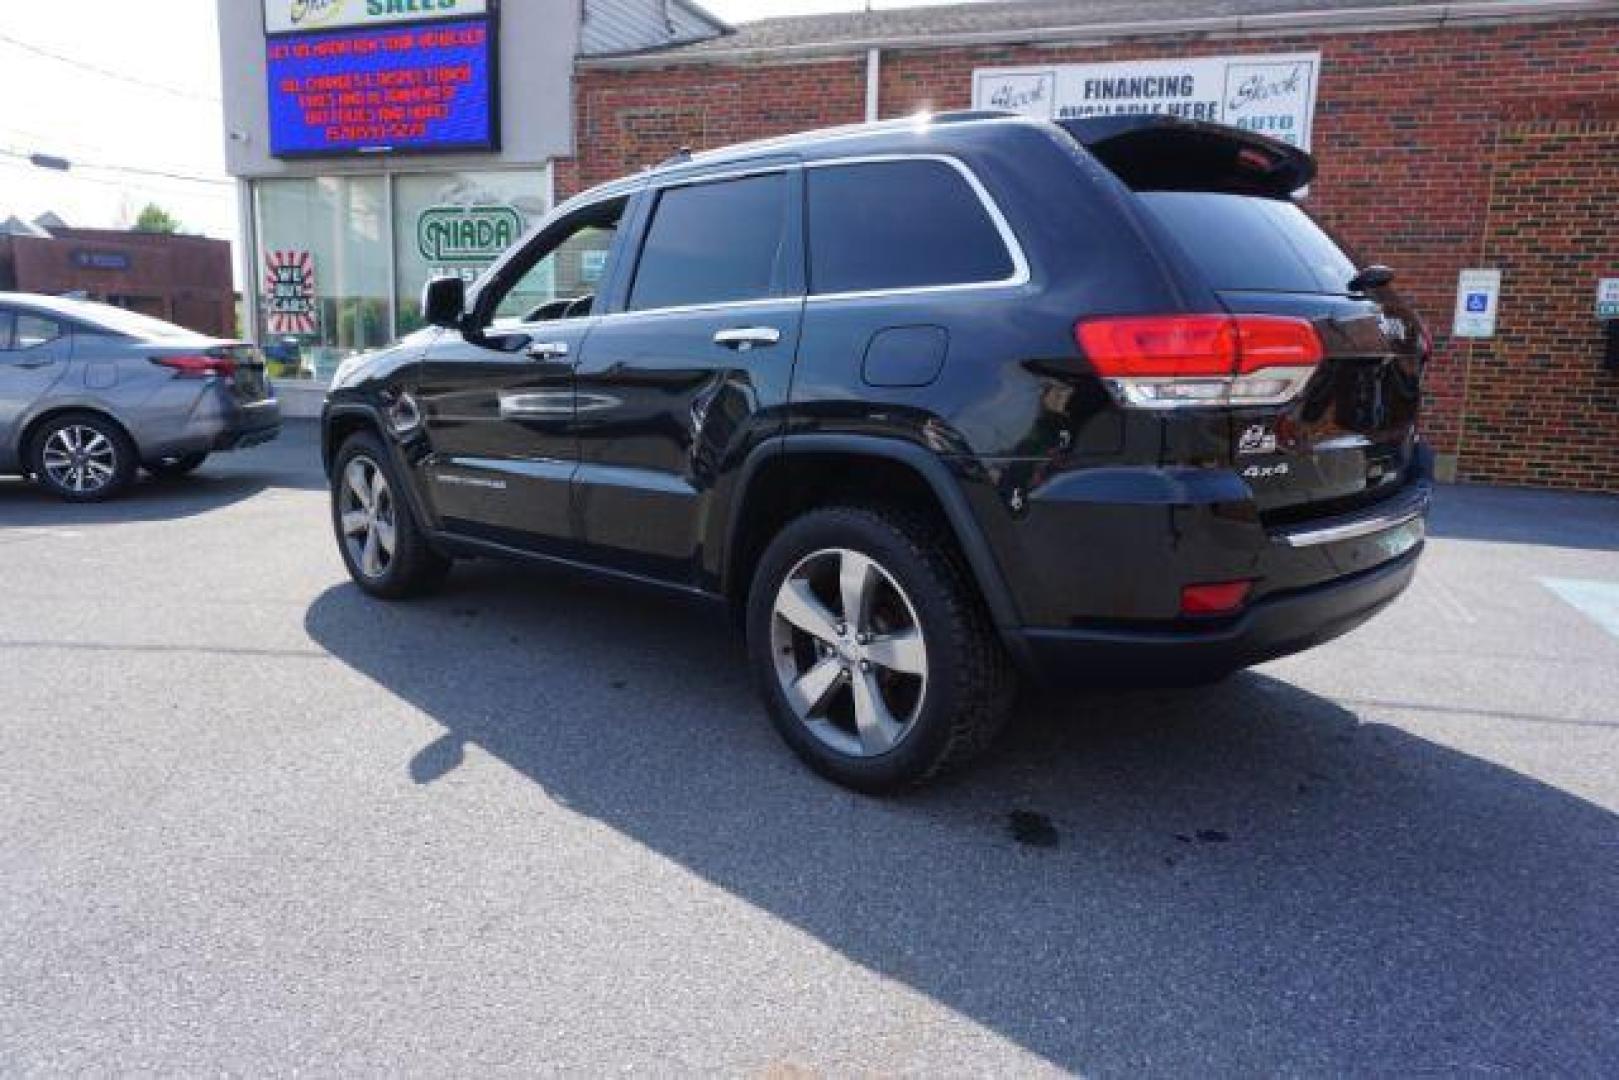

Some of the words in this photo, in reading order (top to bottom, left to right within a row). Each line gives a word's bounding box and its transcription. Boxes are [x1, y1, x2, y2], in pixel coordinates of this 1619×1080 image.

[366, 0, 456, 16] SALES
[1084, 75, 1195, 100] FINANCING
[1168, 101, 1218, 122] HERE
[427, 219, 512, 254] NIADA
